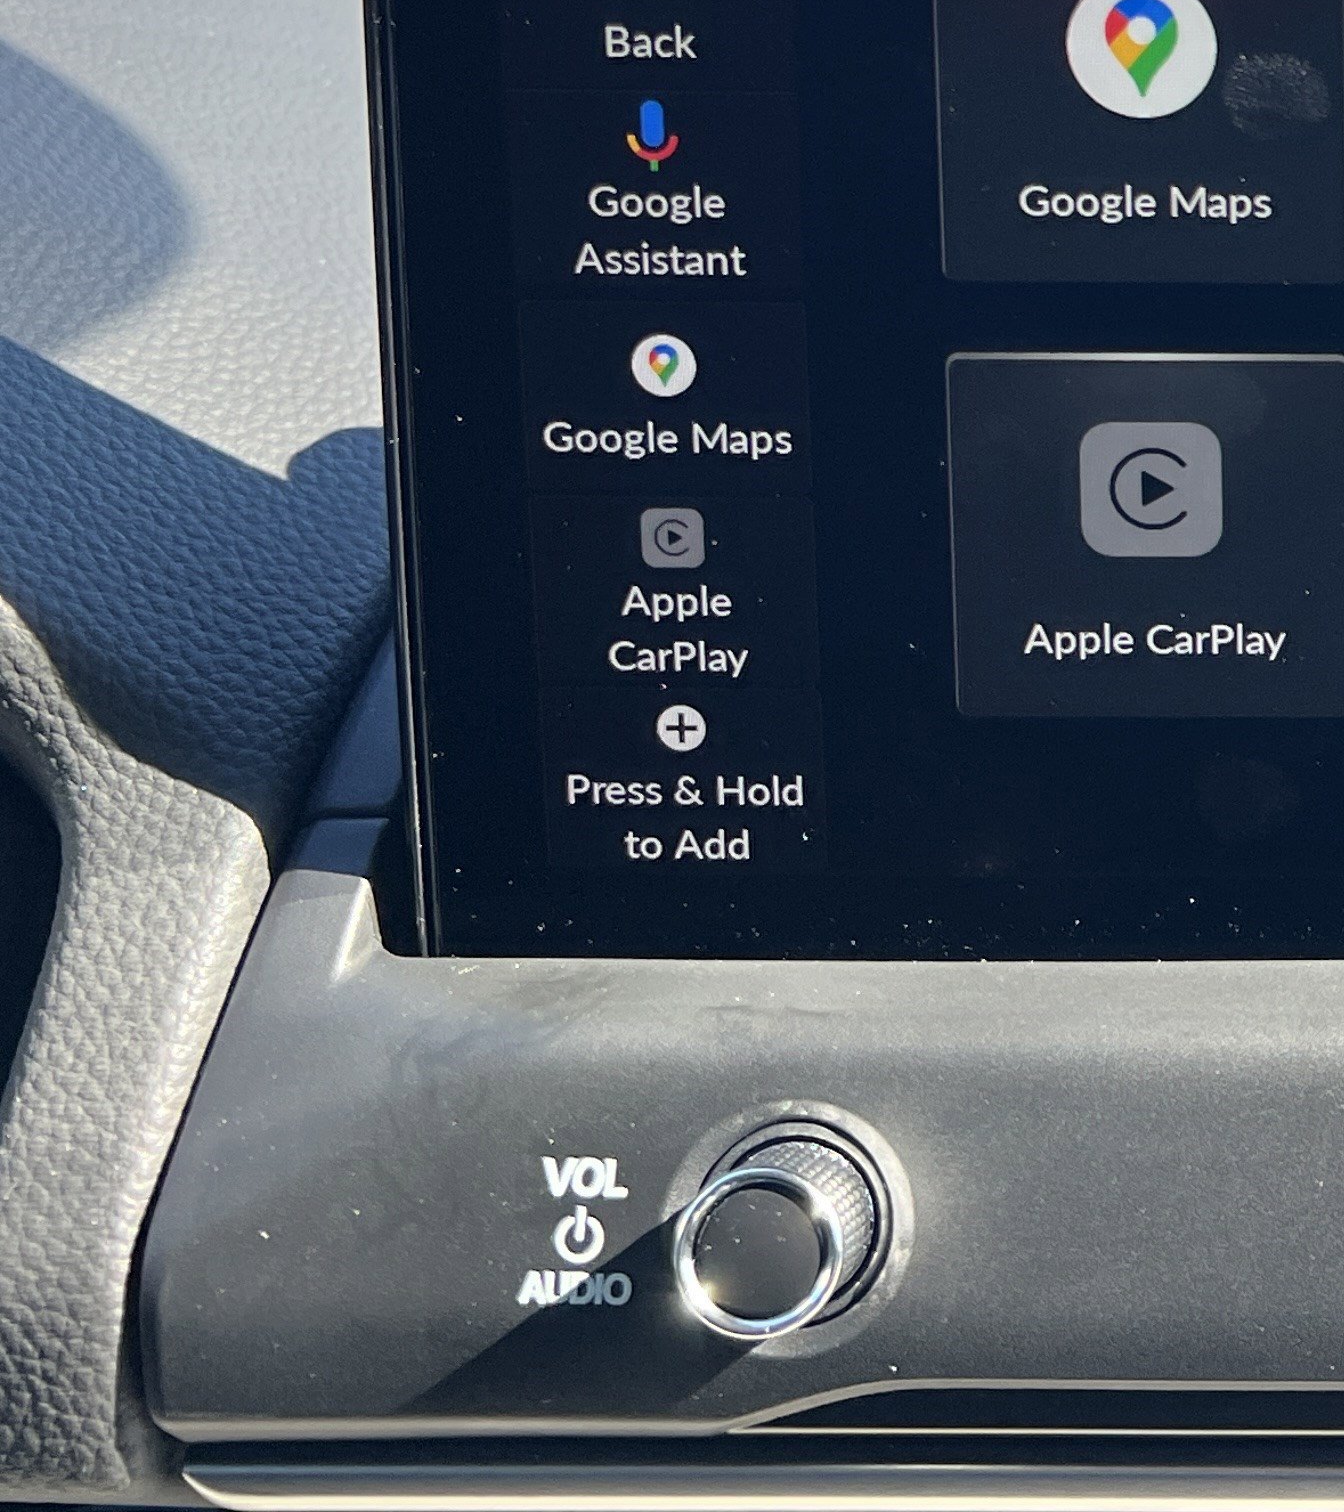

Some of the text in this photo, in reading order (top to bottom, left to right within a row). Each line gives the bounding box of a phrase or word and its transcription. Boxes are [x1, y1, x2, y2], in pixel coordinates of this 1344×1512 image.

[604, 23, 698, 59] Back
[588, 184, 726, 225] Google
[1019, 184, 1272, 225] Google Maps
[574, 242, 747, 276] Assistant
[543, 420, 793, 461] Google Maps
[621, 584, 732, 623] Apple
[608, 640, 749, 678] CarPlay
[1023, 622, 1287, 661] Apple CarPlay
[567, 774, 804, 807] Press & Hold
[623, 828, 750, 861] to Add
[541, 1156, 629, 1198] VOL
[516, 1269, 631, 1306] AUDIO
